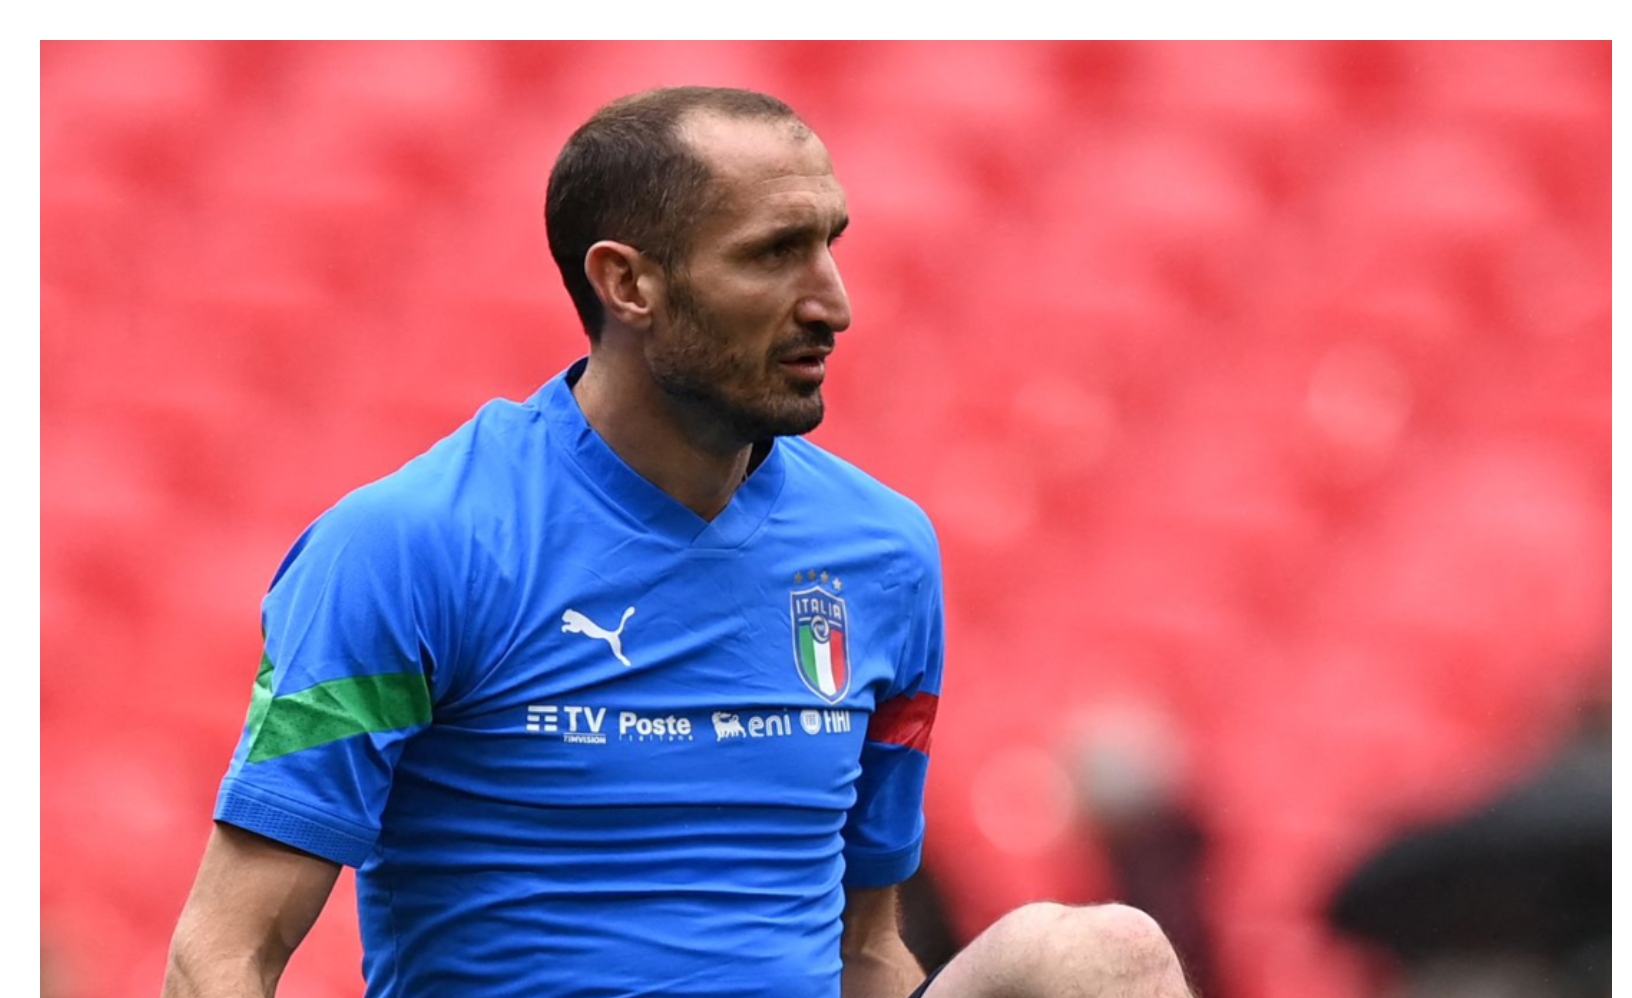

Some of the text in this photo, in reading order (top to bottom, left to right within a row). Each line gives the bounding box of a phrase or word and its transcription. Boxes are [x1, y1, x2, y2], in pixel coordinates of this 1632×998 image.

[796, 598, 842, 621] ITALIA
[563, 705, 607, 733] TV
[619, 710, 692, 736] Poste
[747, 707, 793, 738] eni
